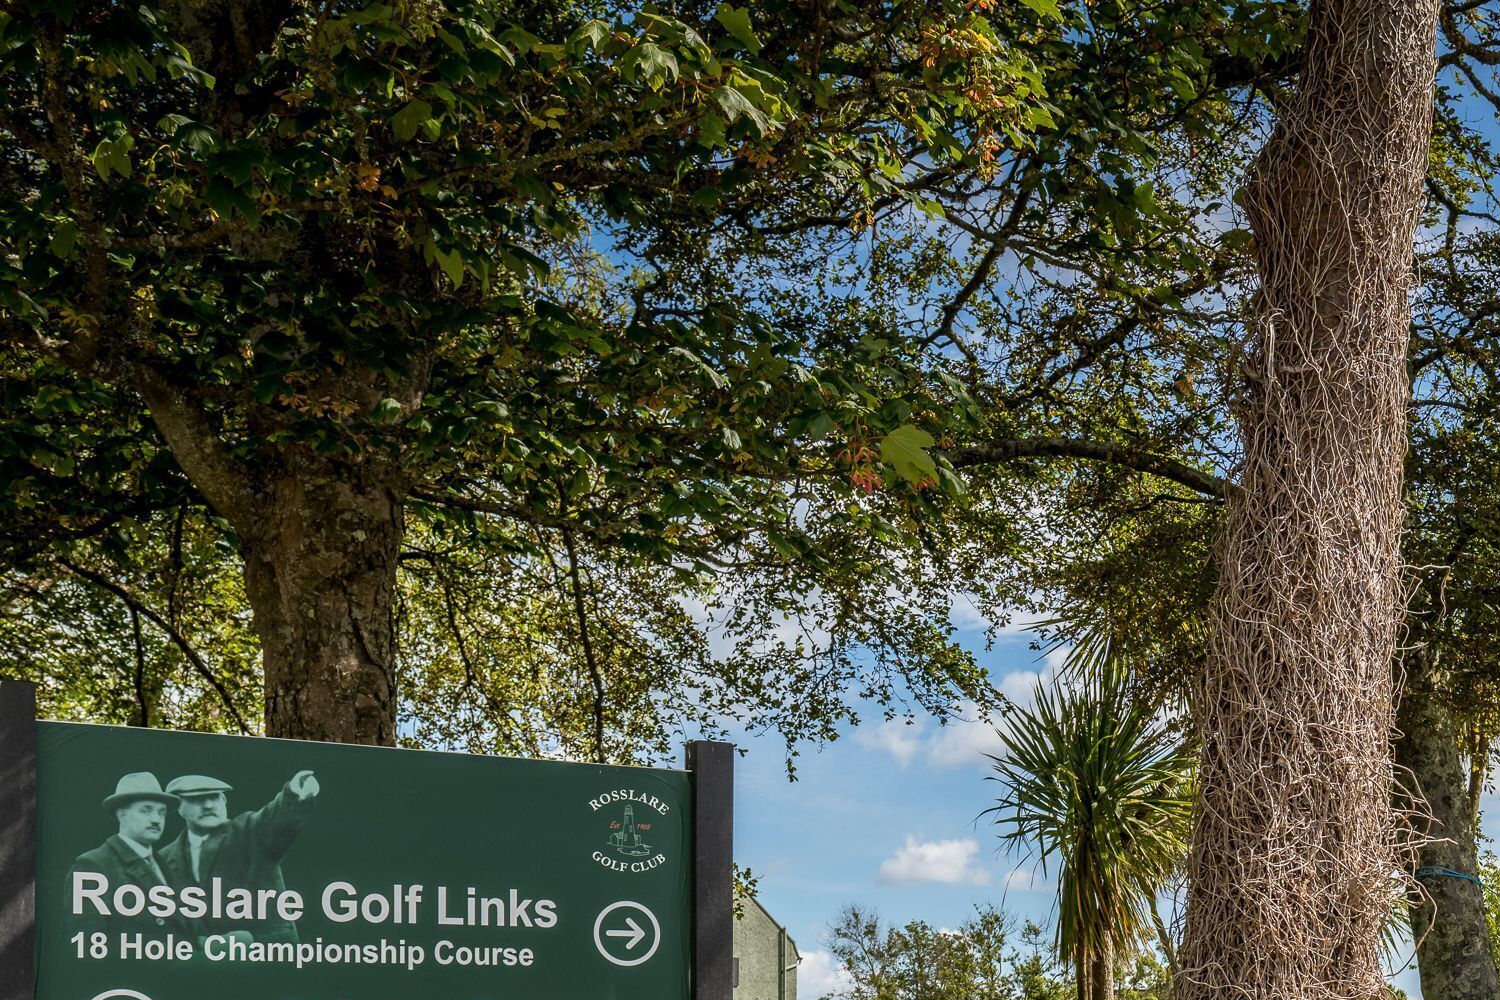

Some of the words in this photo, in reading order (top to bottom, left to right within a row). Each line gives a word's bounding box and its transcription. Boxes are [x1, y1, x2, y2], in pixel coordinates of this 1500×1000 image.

[588, 789, 670, 816] ROSSLARE
[592, 851, 628, 872] GOLF
[630, 853, 666, 873] CLUB
[71, 871, 305, 921] Rosslare
[321, 881, 424, 925] Golf
[437, 886, 559, 929] Links
[70, 932, 108, 959] 18
[120, 932, 194, 962] Hole
[203, 934, 426, 970] Championship
[434, 939, 535, 967] Course
